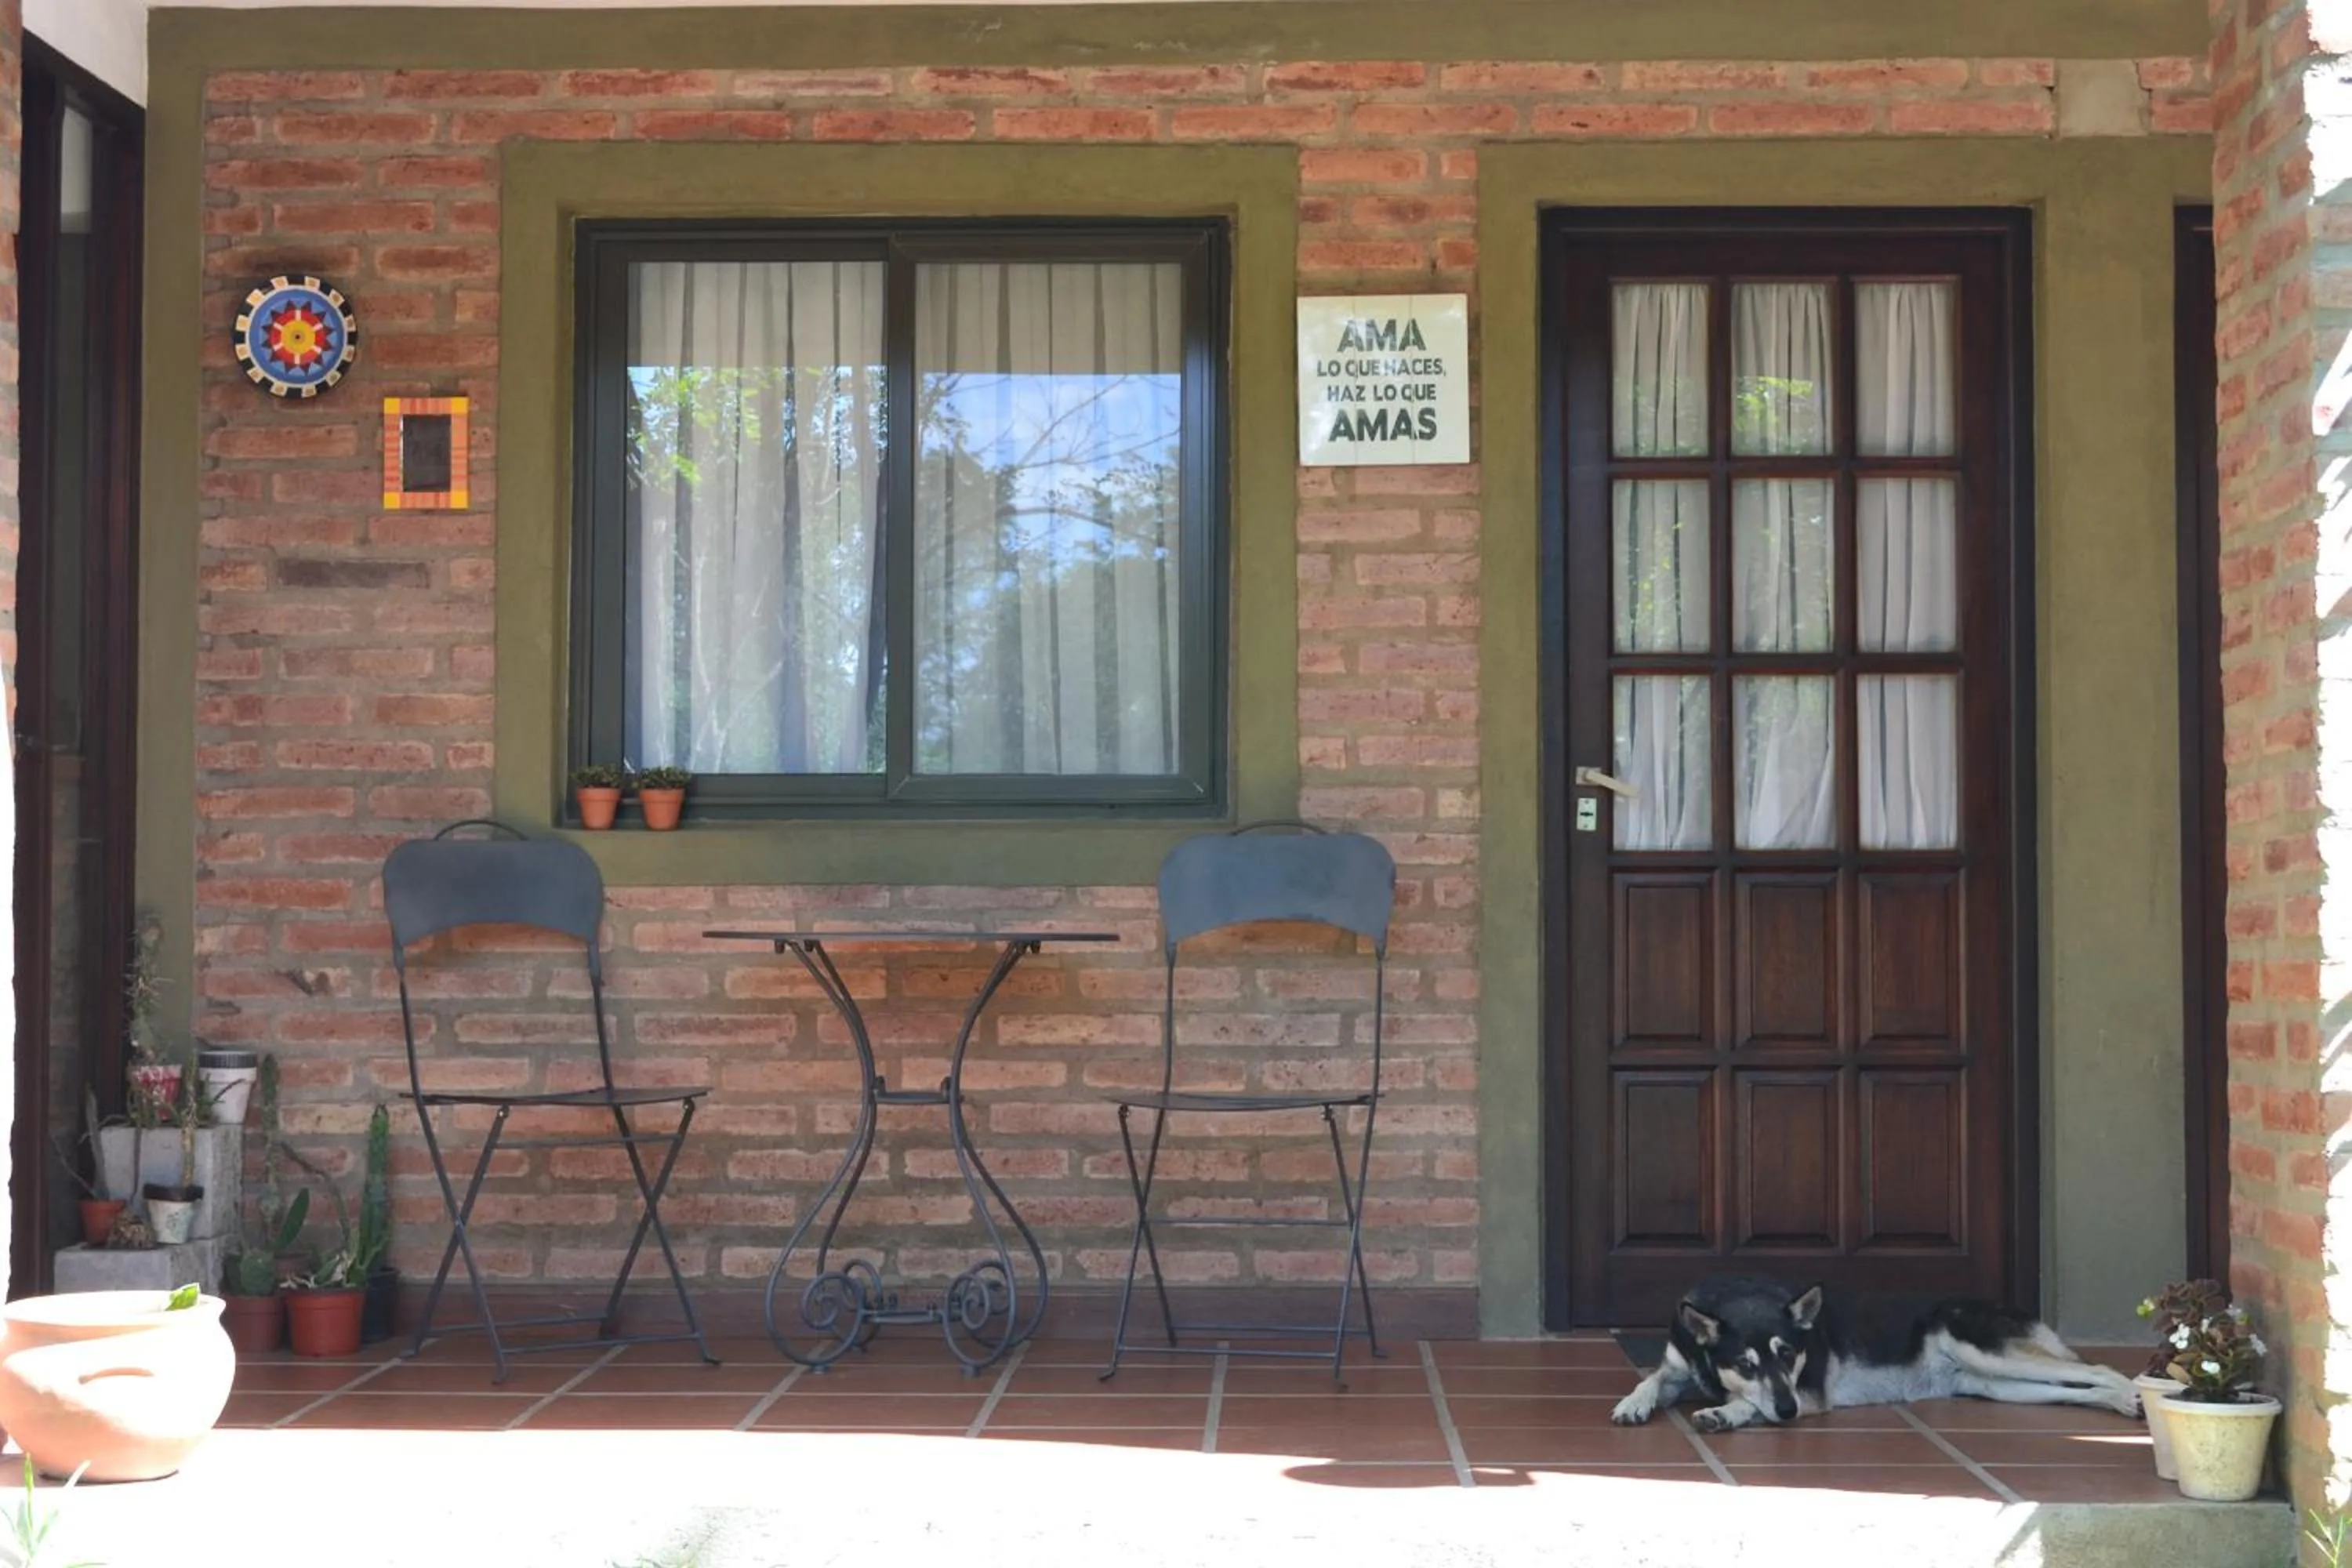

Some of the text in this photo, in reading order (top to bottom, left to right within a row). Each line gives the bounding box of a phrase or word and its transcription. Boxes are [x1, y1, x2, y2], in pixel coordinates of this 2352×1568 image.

[1338, 318, 1426, 352] AMA
[1316, 358, 1446, 378] LO QUE HACES,
[1327, 383, 1437, 401] HAZ LO QUE
[1328, 407, 1438, 442] AMAS
